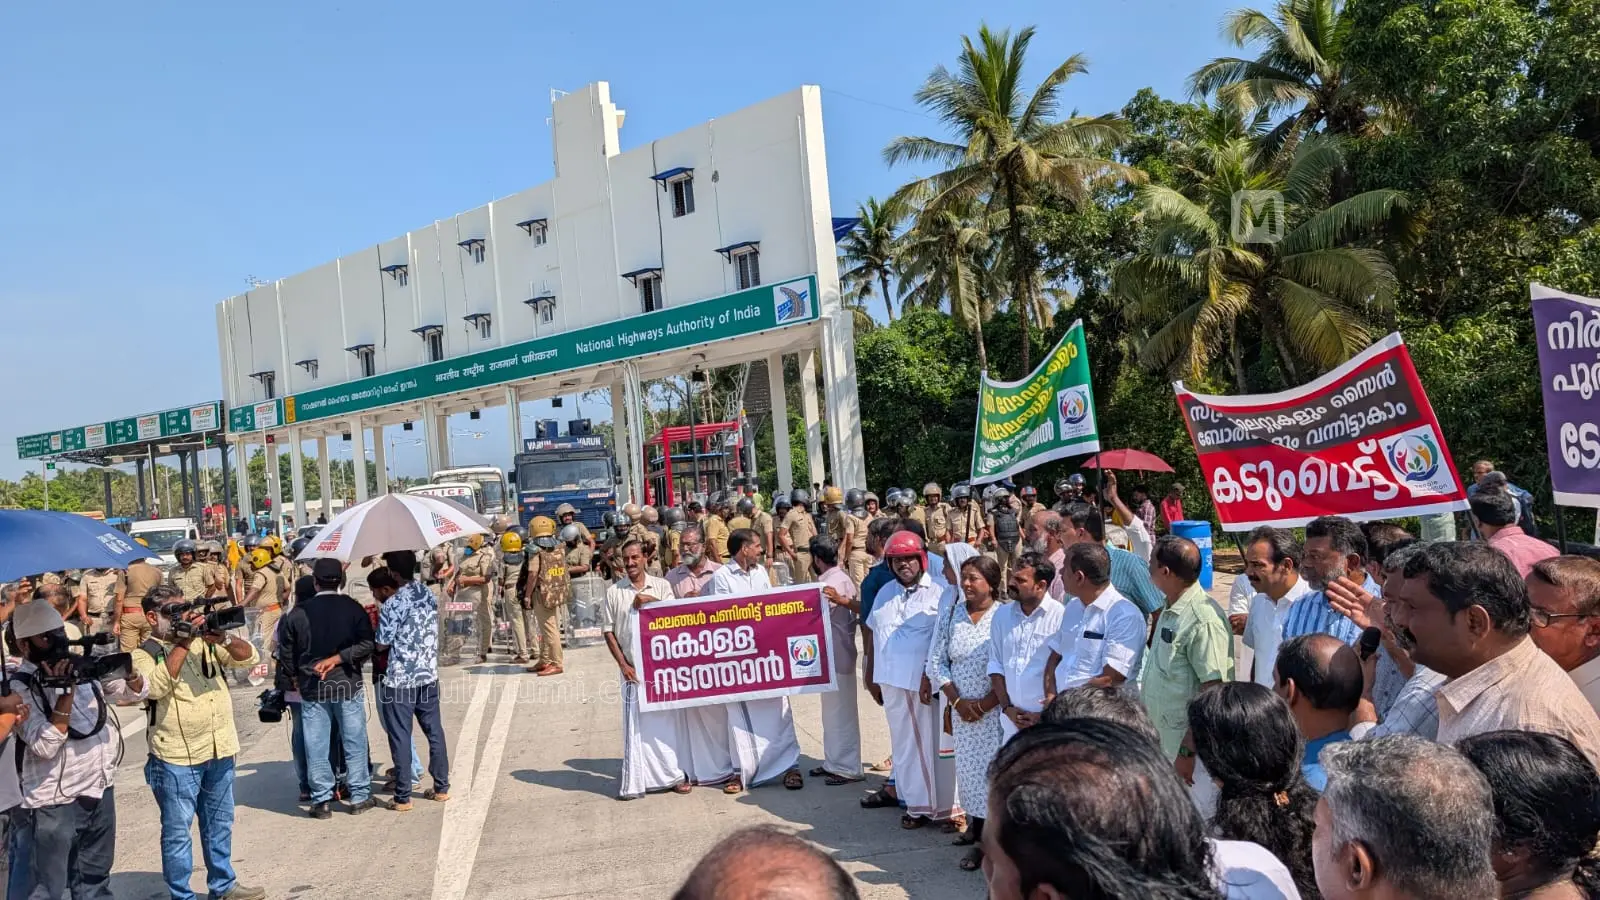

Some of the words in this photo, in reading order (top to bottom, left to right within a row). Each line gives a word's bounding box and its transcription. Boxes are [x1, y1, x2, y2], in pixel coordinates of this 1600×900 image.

[575, 334, 614, 355] National
[617, 327, 664, 347] Highways
[665, 314, 717, 337] Authority
[718, 310, 730, 324] of
[733, 304, 761, 320] India
[435, 366, 459, 382] भारतीय
[462, 362, 485, 378] राष्ट्रीय
[489, 353, 518, 371] राजमार्ग
[521, 348, 558, 364] प्राधिकरण
[1329, 362, 1397, 409] സൈൻ
[127, 424, 133, 437] 3
[181, 415, 187, 427] 4
[246, 412, 251, 425] 5
[1305, 401, 1408, 445] വന്നിട്ടാകാം
[76, 433, 82, 444] 2
[420, 488, 465, 496] OLICE
[1212, 439, 1398, 512] കടുംവെട്ട്
[648, 610, 706, 631] പാലങ്ങൾ
[709, 602, 763, 624] പണിതിട്ട്
[651, 625, 758, 661] കൊള്ള
[653, 650, 785, 695] നടത്താൻ
